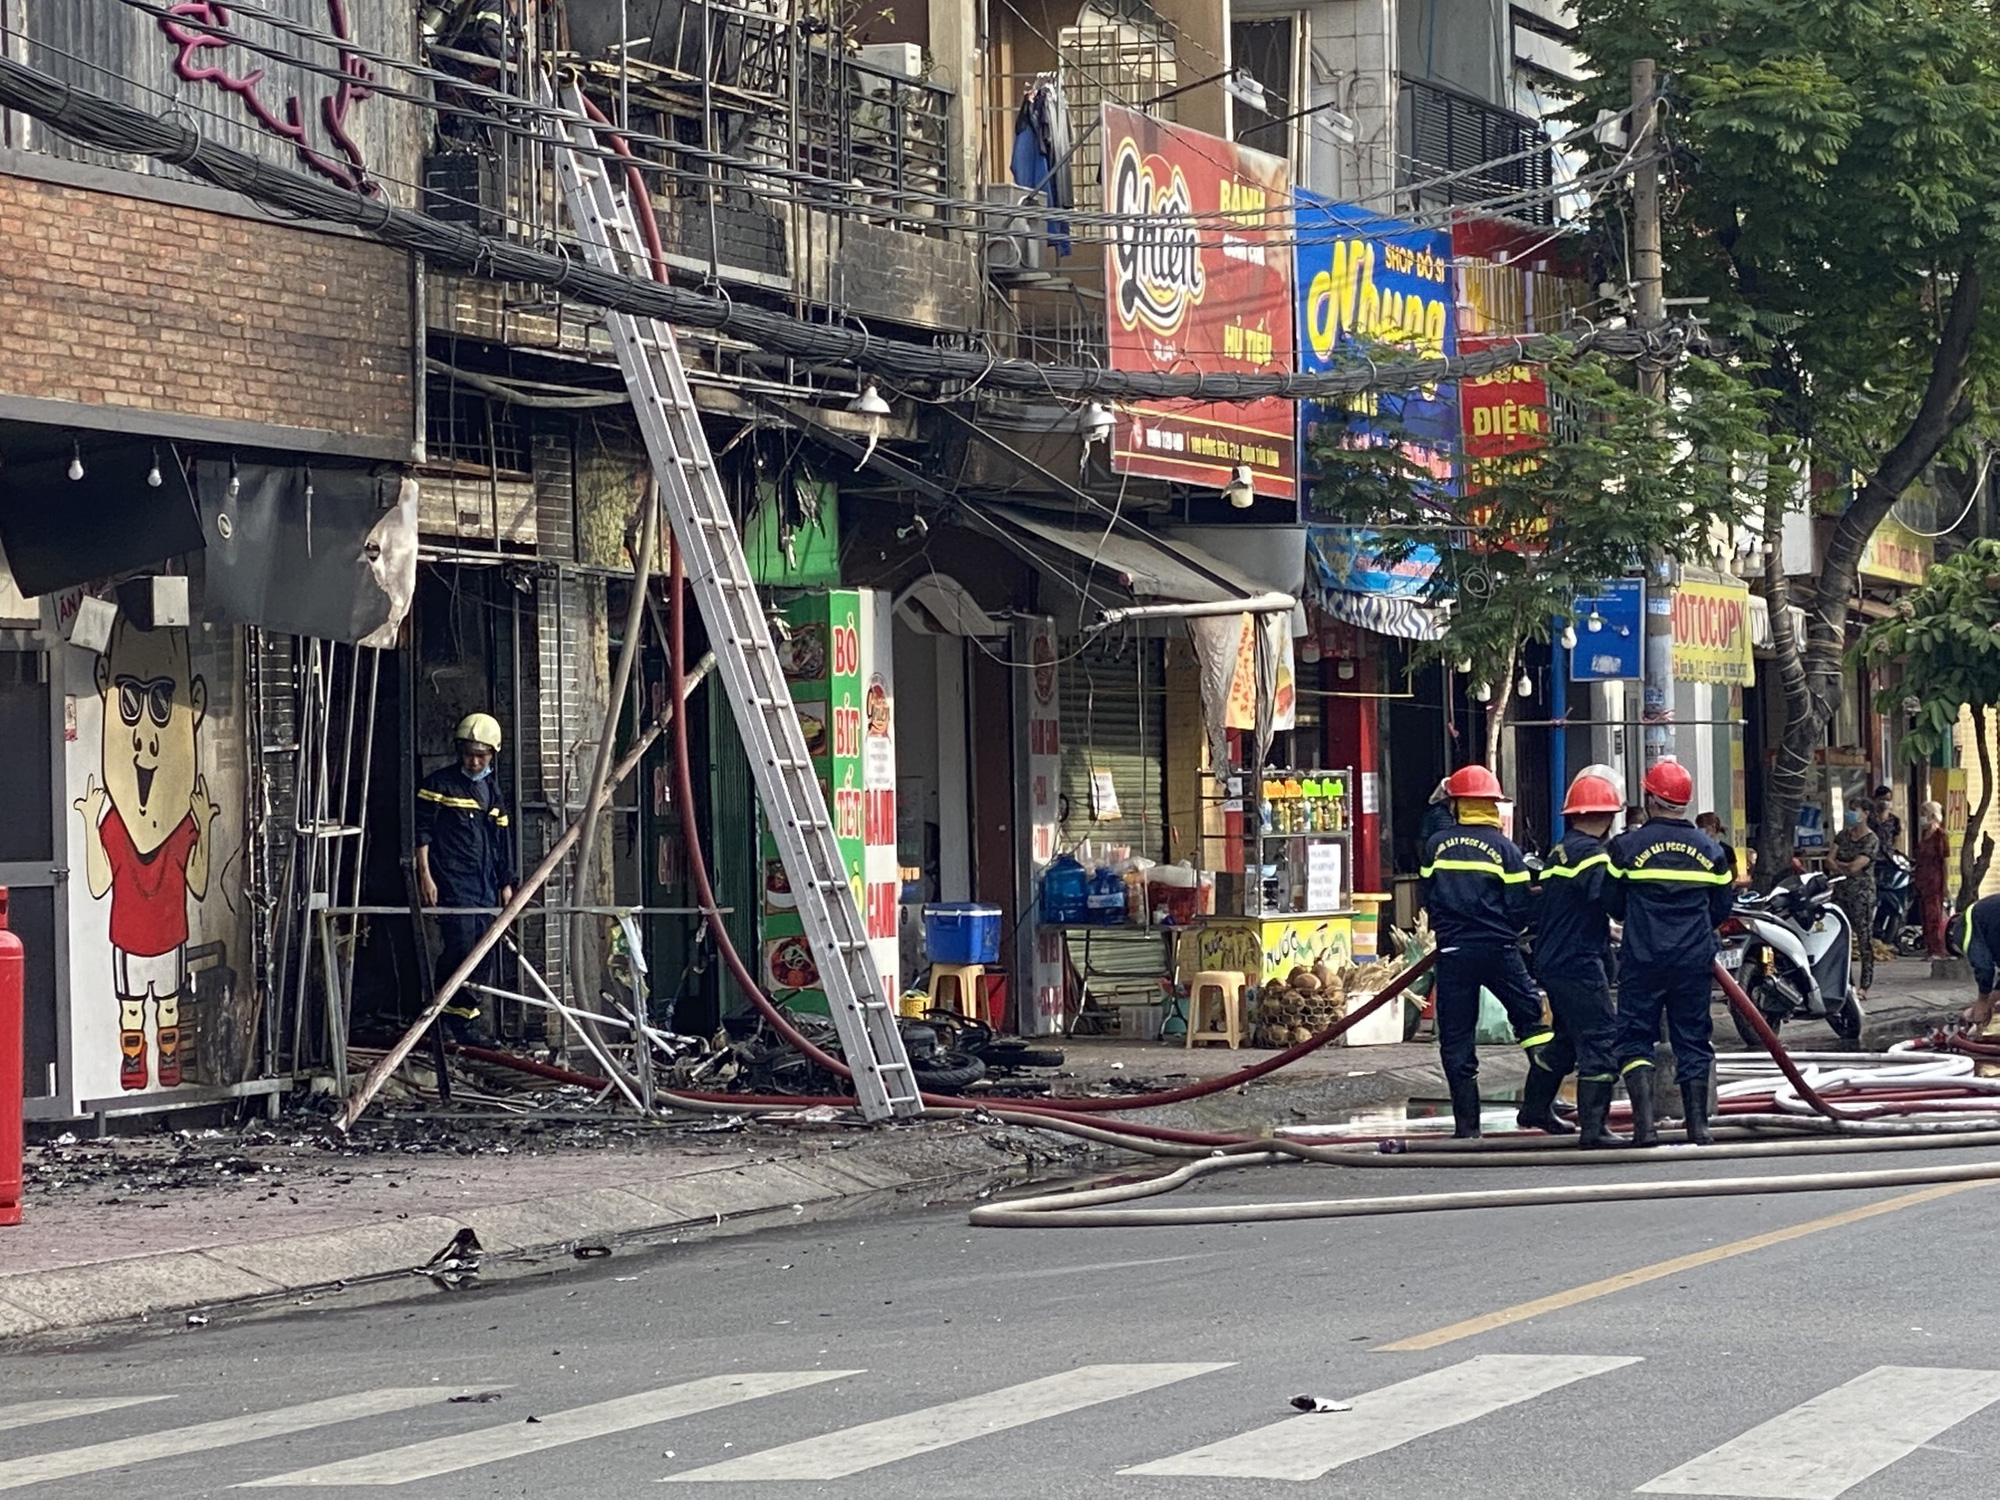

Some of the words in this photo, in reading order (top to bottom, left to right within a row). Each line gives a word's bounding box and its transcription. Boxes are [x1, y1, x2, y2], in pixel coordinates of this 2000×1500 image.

[1385, 243, 1414, 275] SHOP
[1434, 257, 1446, 284] SI
[1308, 239, 1447, 402] Nhung
[1473, 399, 1540, 441] ĐIỆN
[833, 611, 859, 677] BÒ
[1670, 592, 1745, 653] HOTOCOPY
[834, 692, 861, 758] BÍT
[835, 764, 863, 839] TẾT
[1460, 837, 1480, 848] PCCC
[1665, 841, 1687, 853] PCCC
[867, 882, 897, 940] CANH
